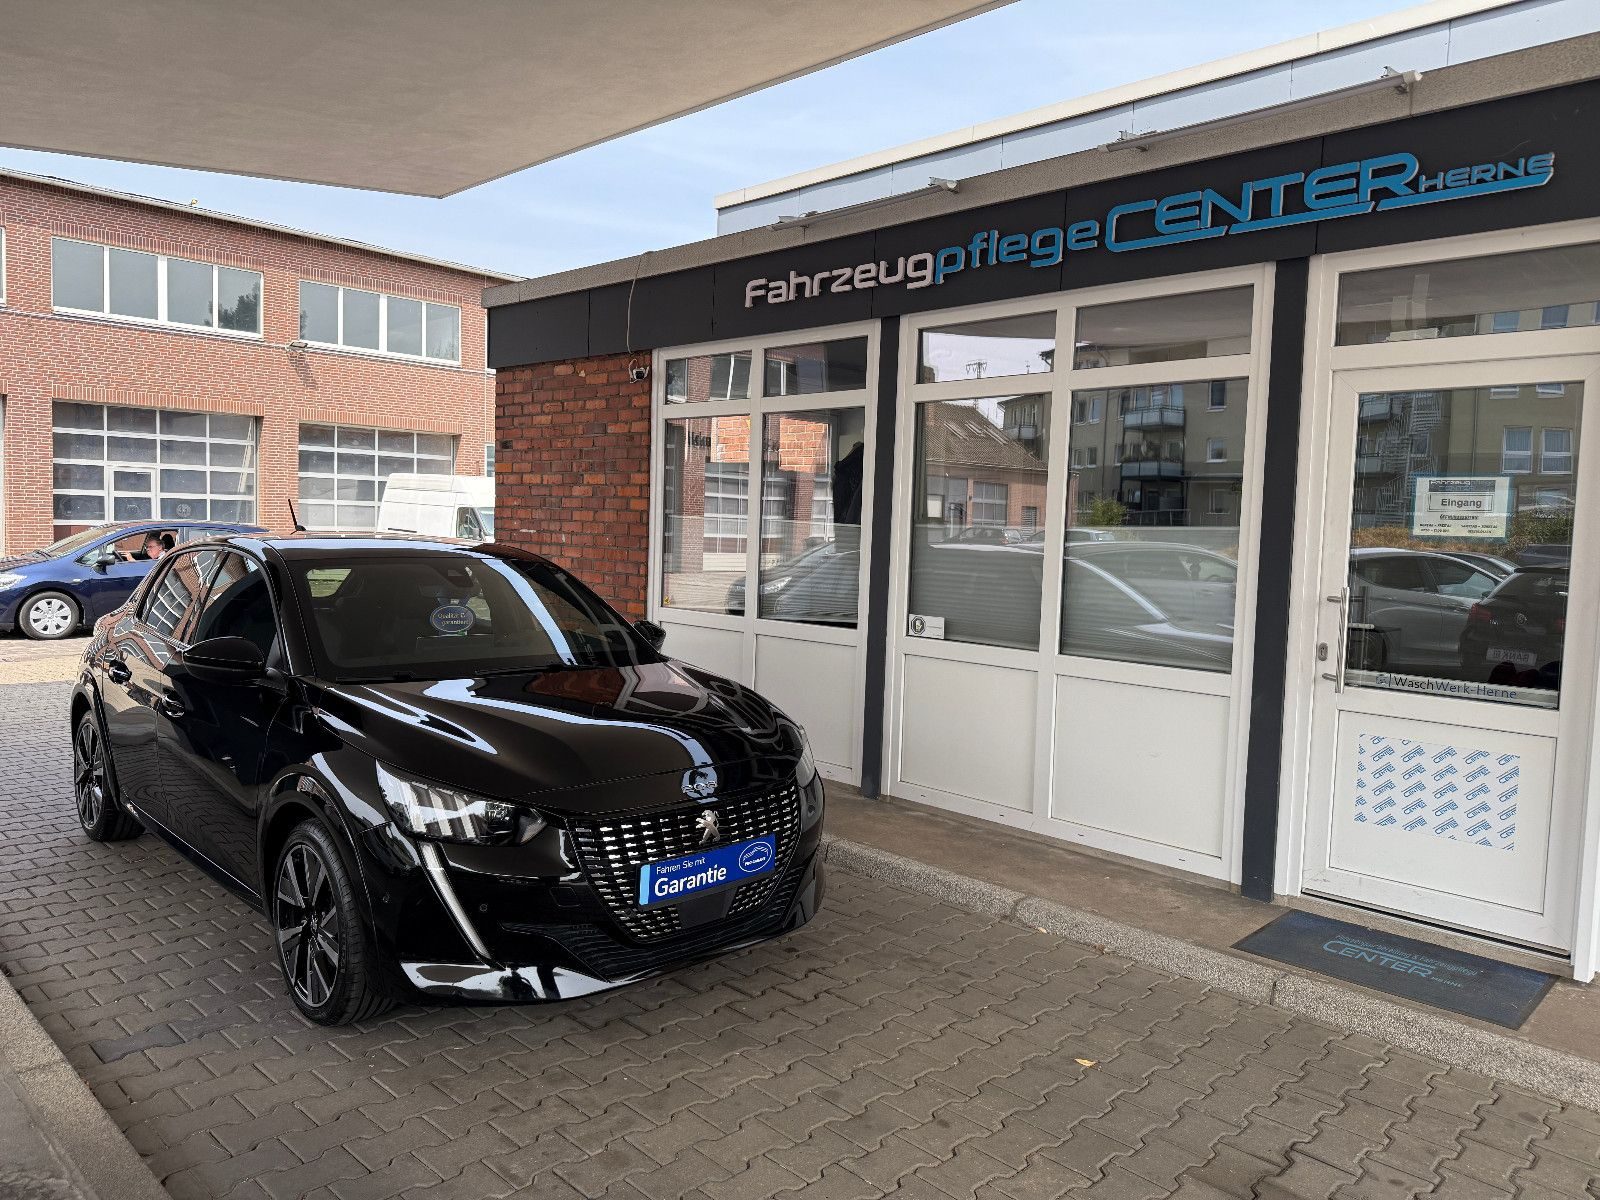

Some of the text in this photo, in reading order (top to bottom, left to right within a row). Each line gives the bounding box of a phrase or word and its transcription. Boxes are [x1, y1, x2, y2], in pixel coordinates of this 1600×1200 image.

[1105, 152, 1419, 252] CENTER
[1418, 152, 1555, 193] HERNE
[1441, 498, 1482, 508] Eingang
[1393, 675, 1517, 699] WaschWerk-Herne
[656, 857, 706, 874] Fahren Sie mit
[654, 864, 727, 897] Garantie
[1322, 940, 1433, 978] CENTER
